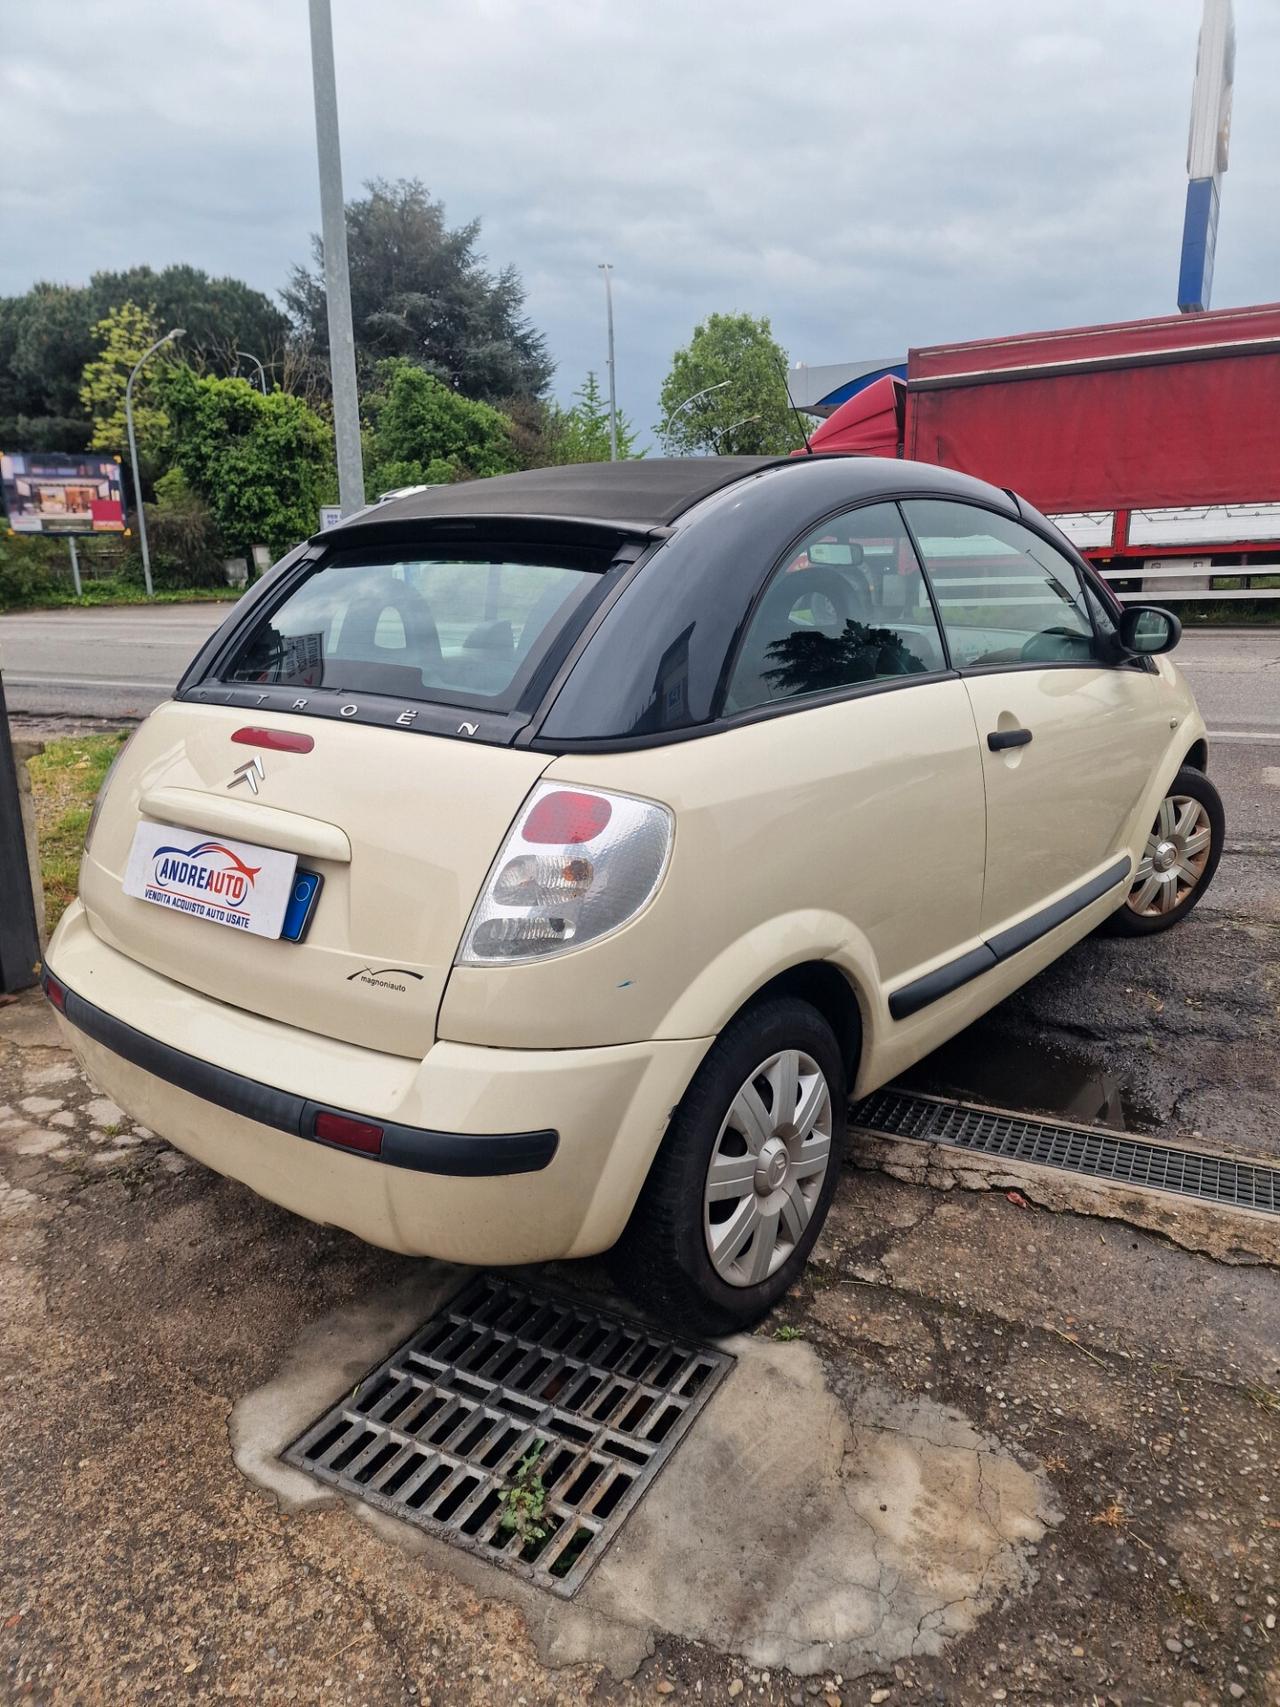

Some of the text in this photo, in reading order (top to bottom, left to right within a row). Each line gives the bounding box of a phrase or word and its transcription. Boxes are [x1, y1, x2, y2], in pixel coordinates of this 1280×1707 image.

[199, 691, 480, 736] CITROËN
[160, 858, 244, 899] ANDREAUTO
[144, 889, 250, 928] VENDITA ACQUISTO AUTO USATE
[360, 975, 406, 993] magnoniauto
